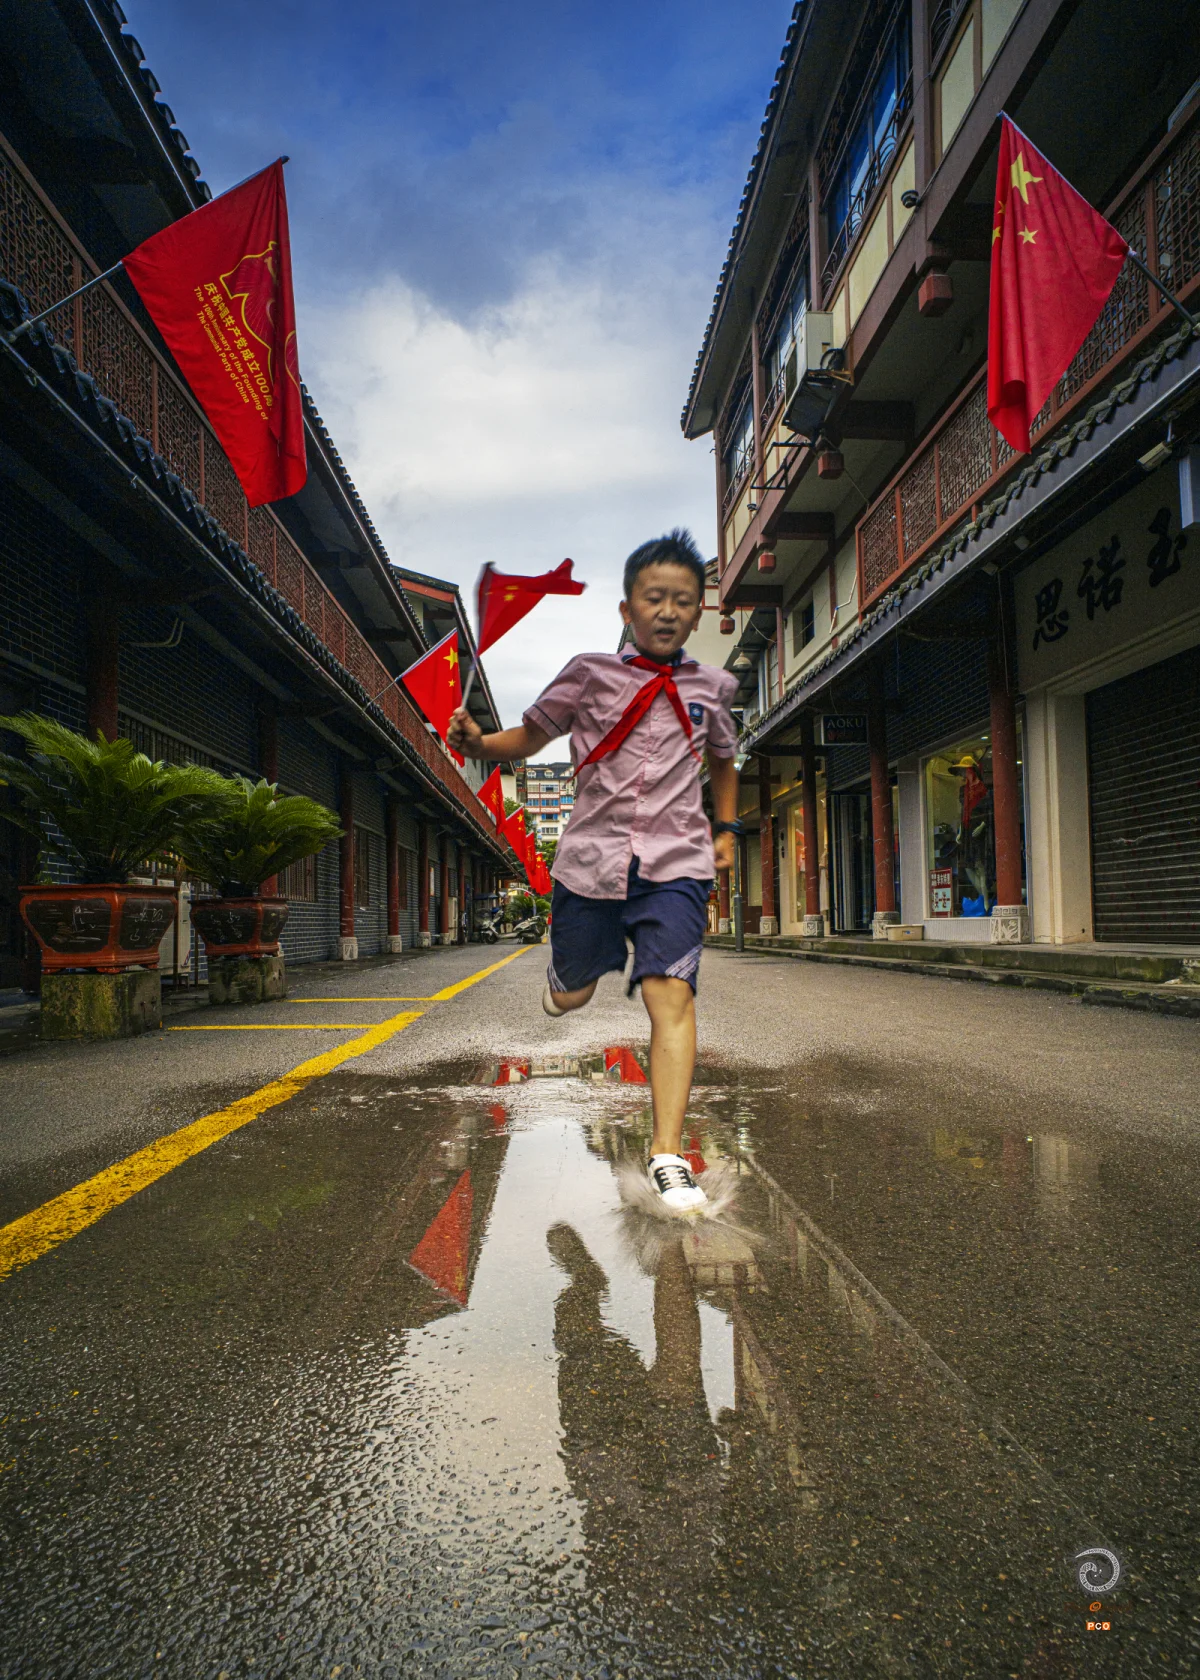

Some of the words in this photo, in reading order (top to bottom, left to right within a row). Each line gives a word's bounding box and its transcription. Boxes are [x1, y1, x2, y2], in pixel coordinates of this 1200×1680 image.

[194, 286, 204, 302] The
[203, 303, 215, 321] 100th
[229, 352, 238, 361] of
[234, 360, 244, 373] the
[241, 373, 264, 411] Founding
[261, 411, 269, 420] of
[197, 310, 206, 324] The
[203, 323, 221, 353] Communist
[219, 352, 232, 372] Party
[230, 373, 239, 381] of
[235, 381, 250, 404] China
[827, 717, 864, 729] AOKU
